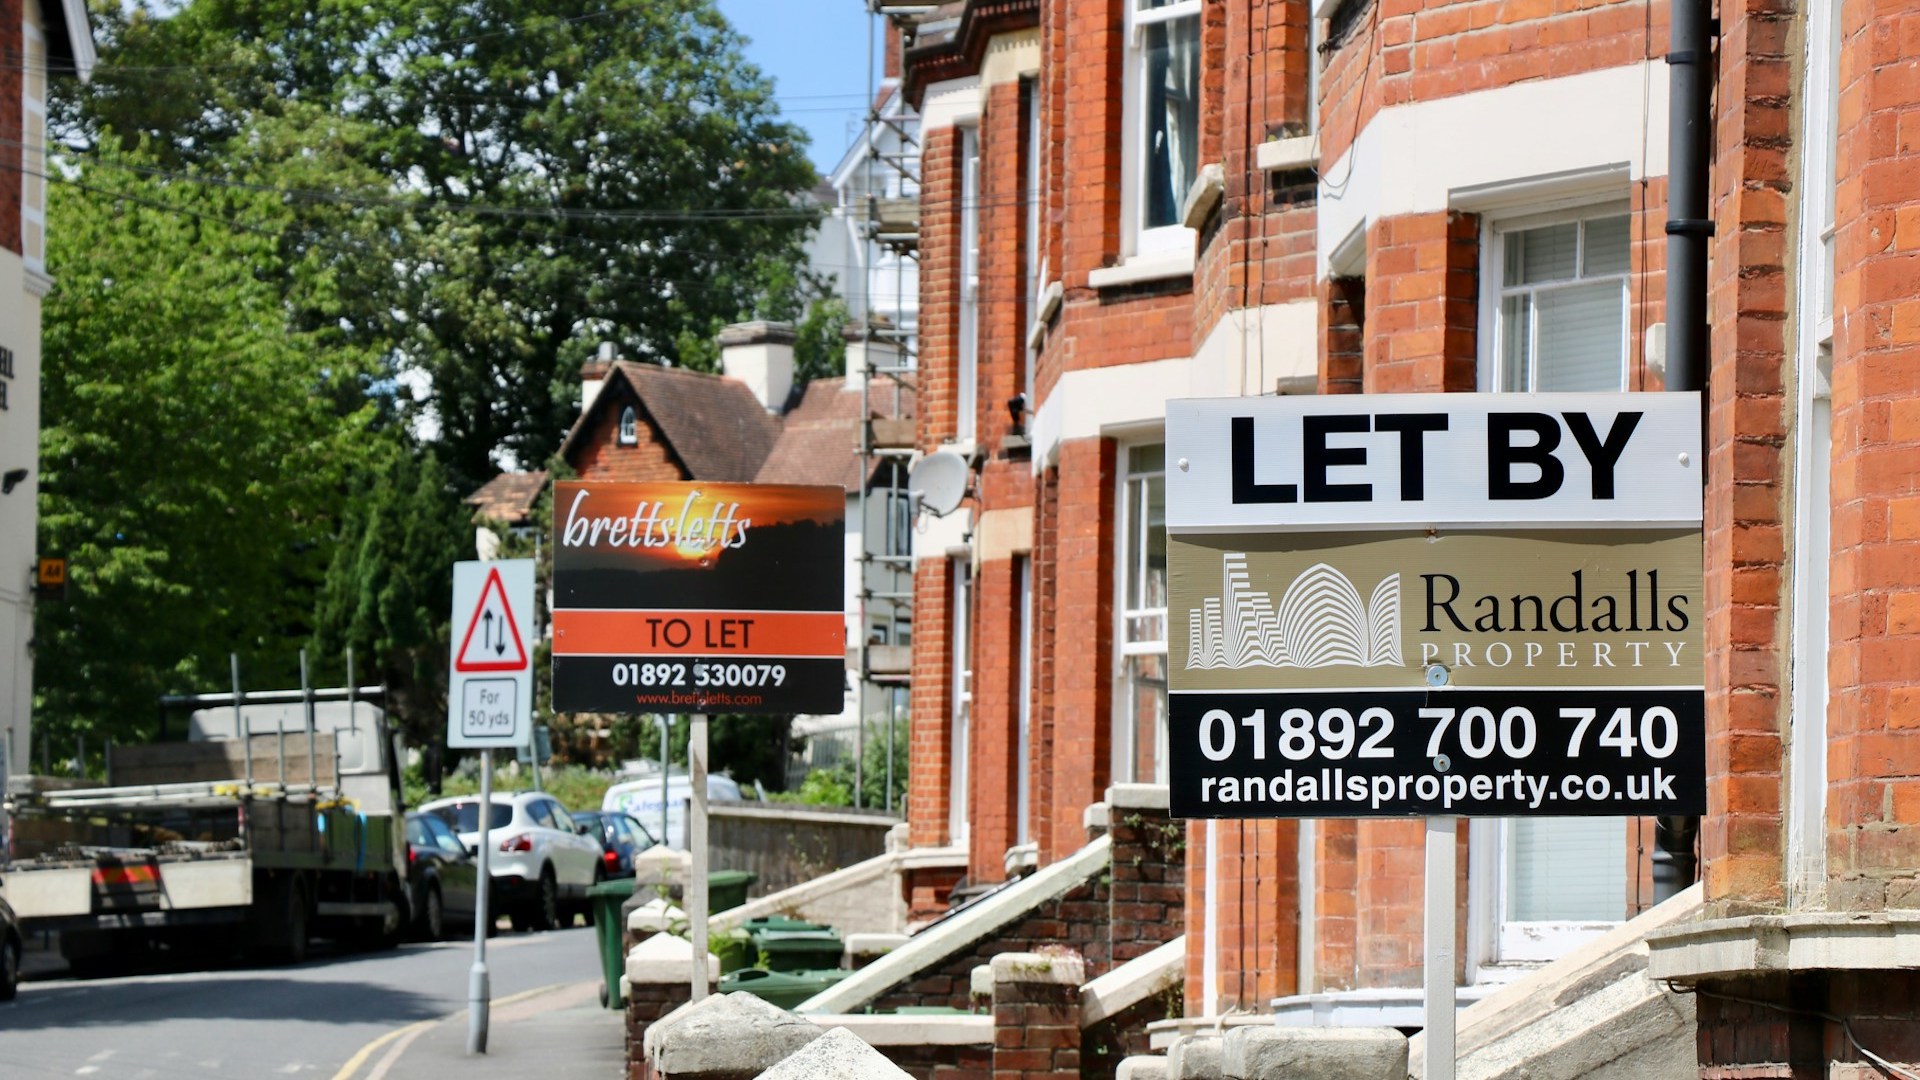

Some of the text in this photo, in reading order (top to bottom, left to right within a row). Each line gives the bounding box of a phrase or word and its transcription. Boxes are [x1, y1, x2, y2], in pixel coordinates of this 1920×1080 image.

[1231, 411, 1644, 504] LET BY
[562, 488, 752, 549] brettsletts
[1419, 568, 1689, 634] Randalls
[646, 618, 755, 649] TO LET
[1420, 641, 1687, 668] PROPERTY
[612, 662, 786, 687] 01892 530079
[480, 688, 500, 704] For
[469, 709, 510, 729] 50 yds
[1198, 705, 1679, 762] 01892 700 740
[1201, 767, 1677, 810] randallsproperty.co.uk
